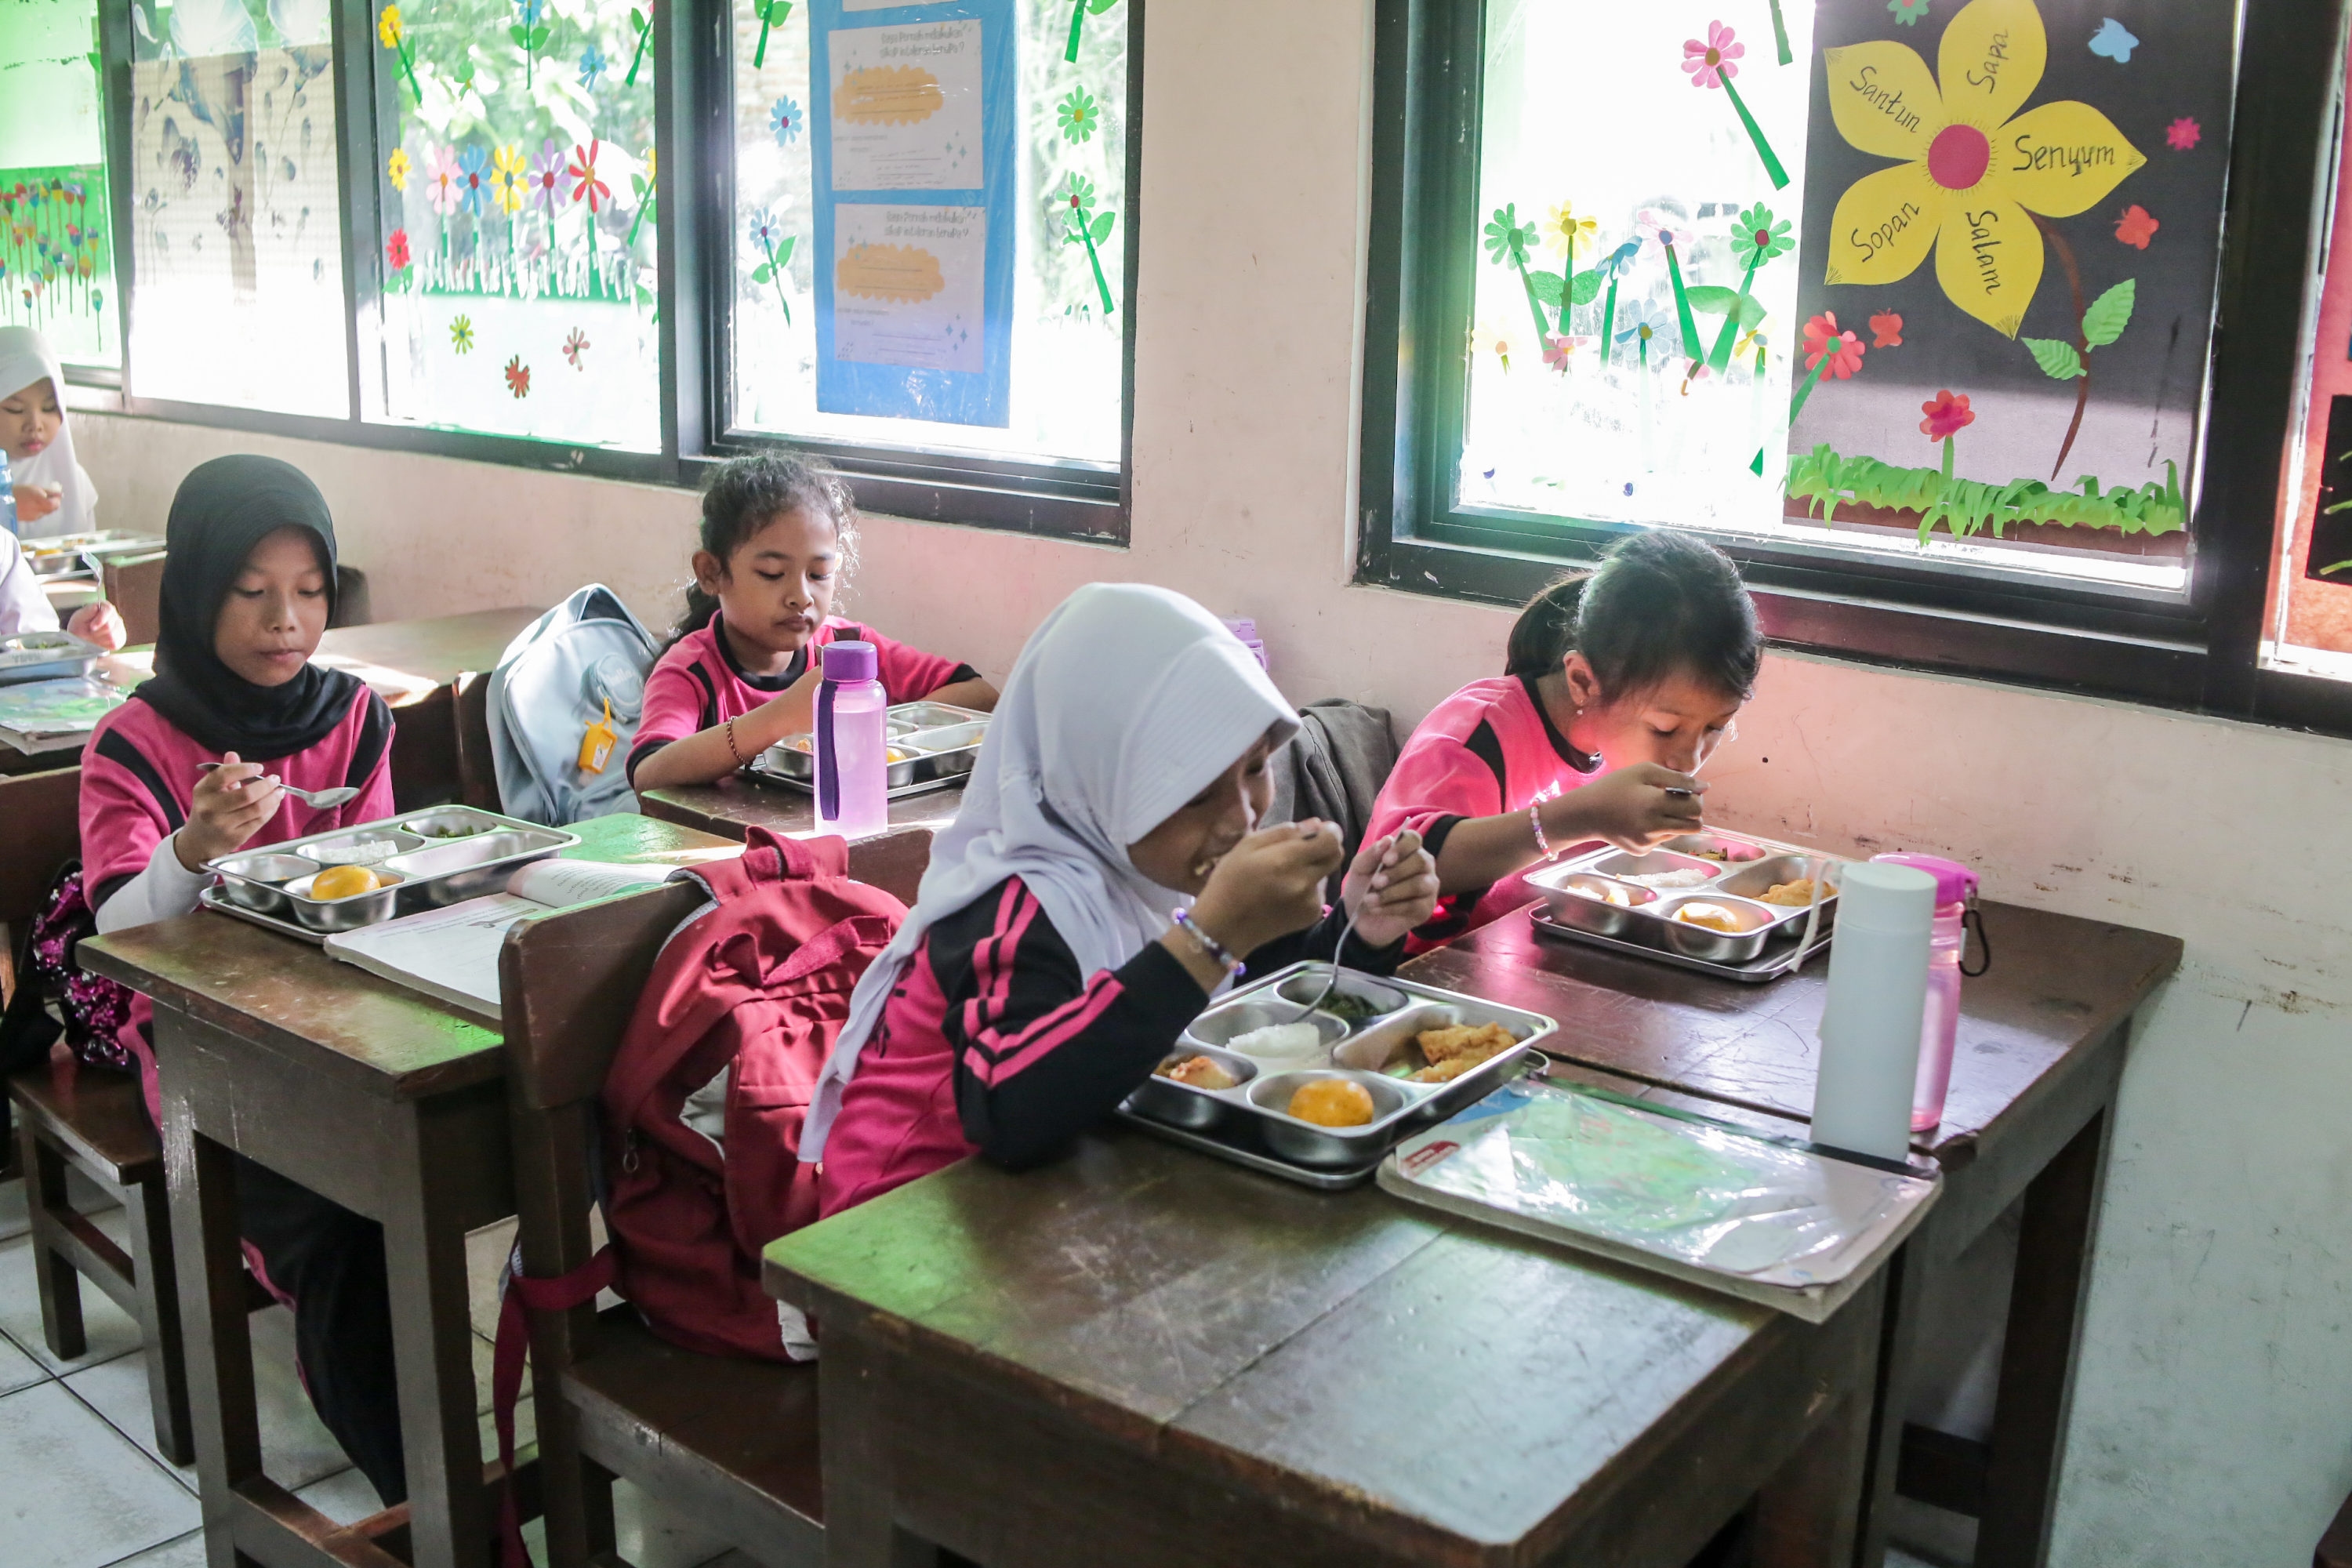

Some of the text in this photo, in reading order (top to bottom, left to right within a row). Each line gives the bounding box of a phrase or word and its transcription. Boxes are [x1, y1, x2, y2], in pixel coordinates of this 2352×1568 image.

[1967, 29, 2009, 94] Sapa
[1849, 66, 1921, 133] Santun
[2013, 134, 2115, 177] Senyum
[1850, 202, 1920, 263] Sopan
[1965, 209, 2002, 296] Salam
